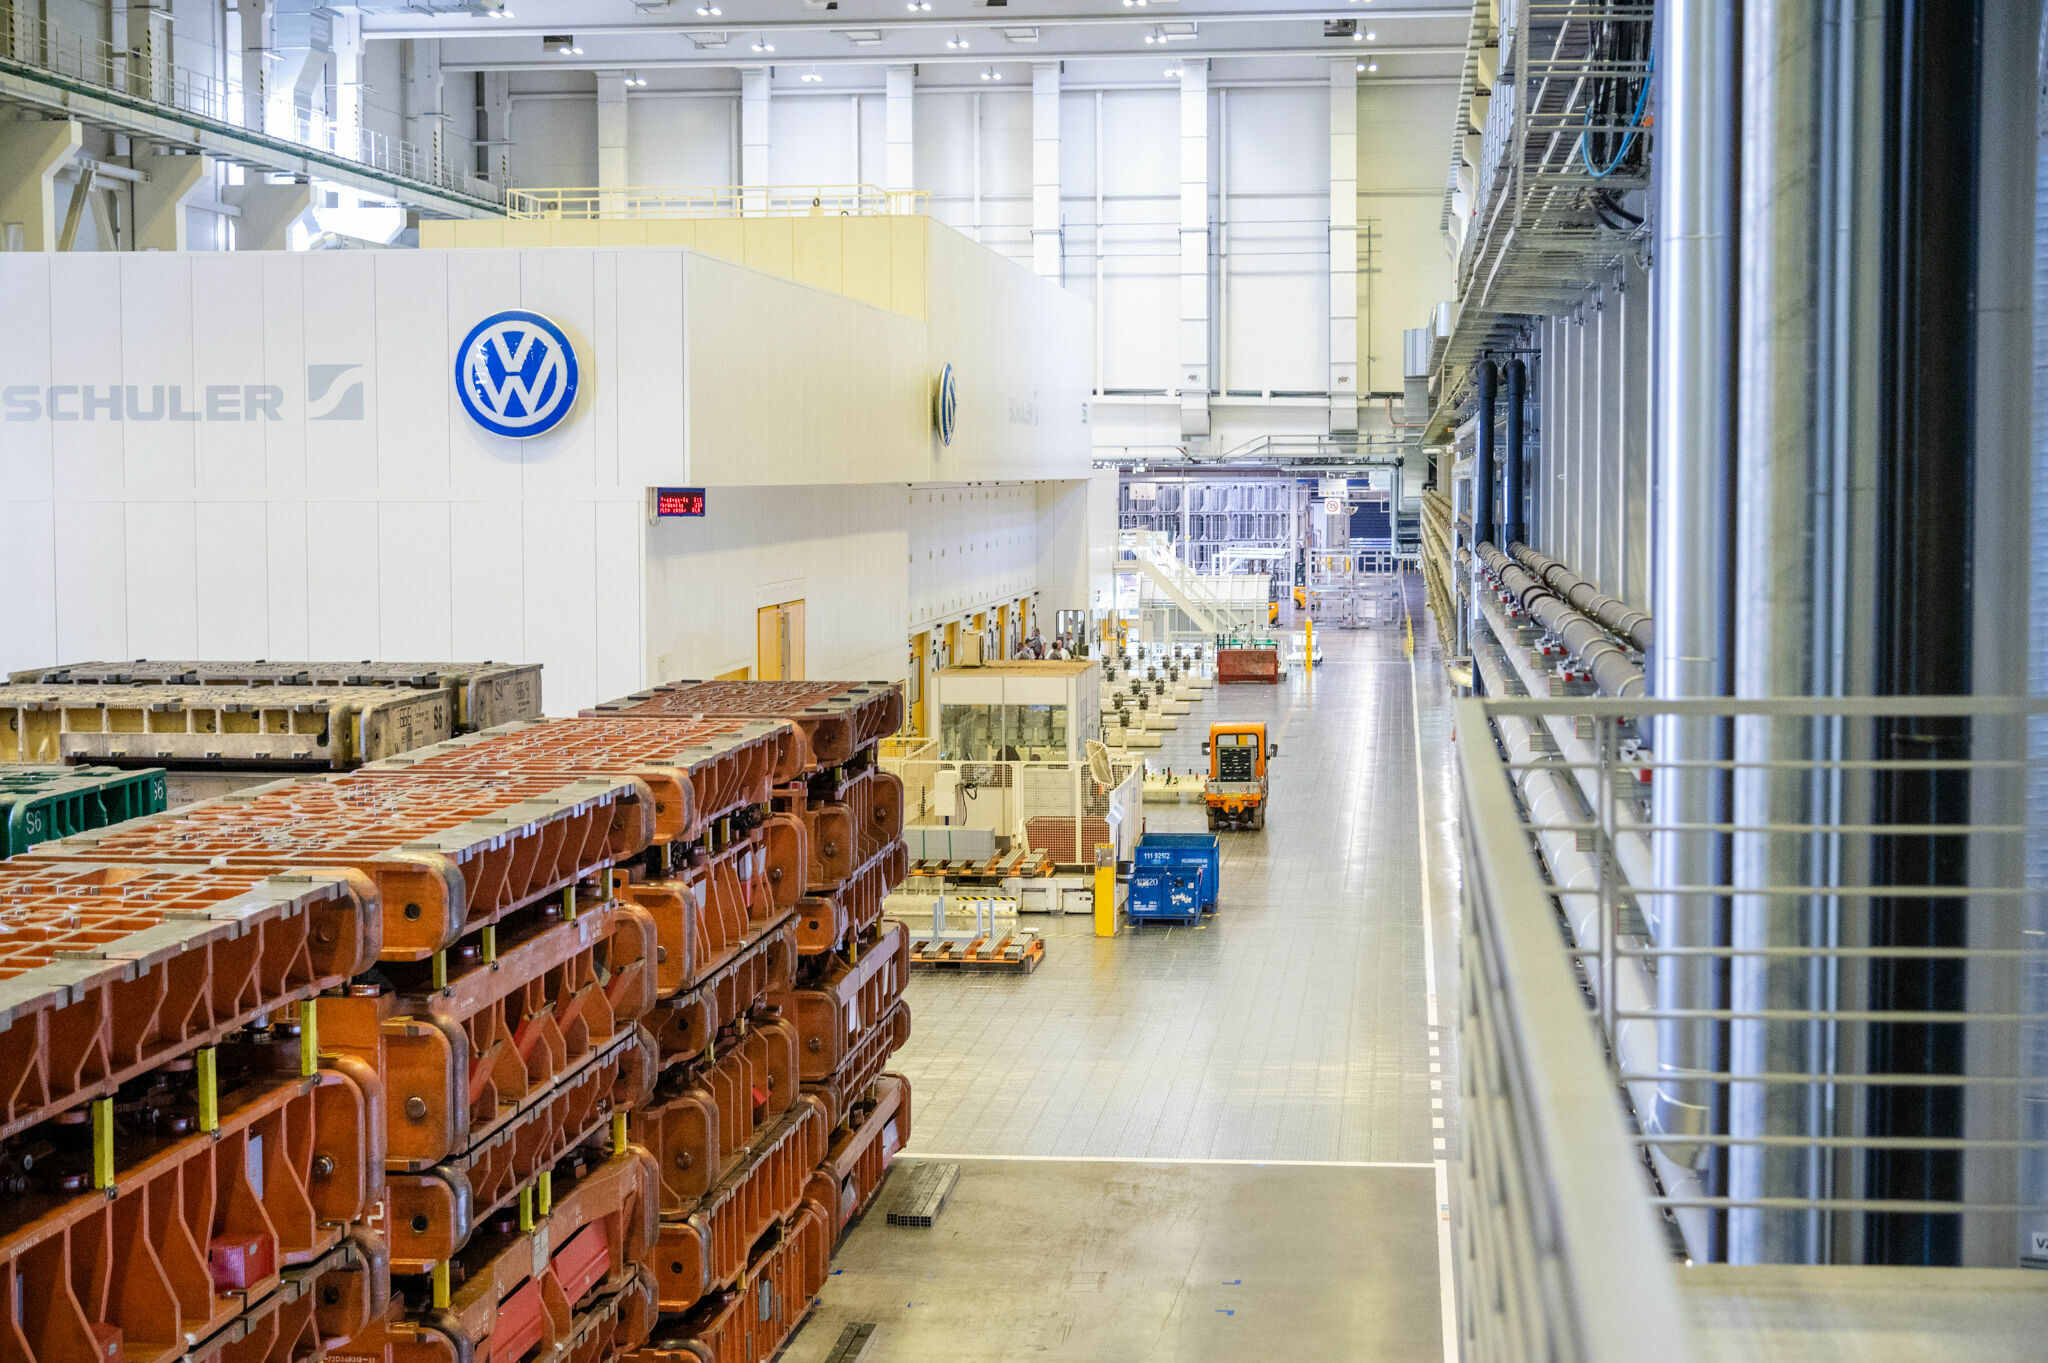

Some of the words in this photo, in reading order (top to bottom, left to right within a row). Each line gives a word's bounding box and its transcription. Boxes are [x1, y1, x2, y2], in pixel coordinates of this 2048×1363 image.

[464, 321, 567, 427] VW
[2, 385, 285, 422] SCHULER
[433, 705, 442, 730] S6
[26, 811, 41, 835] S6
